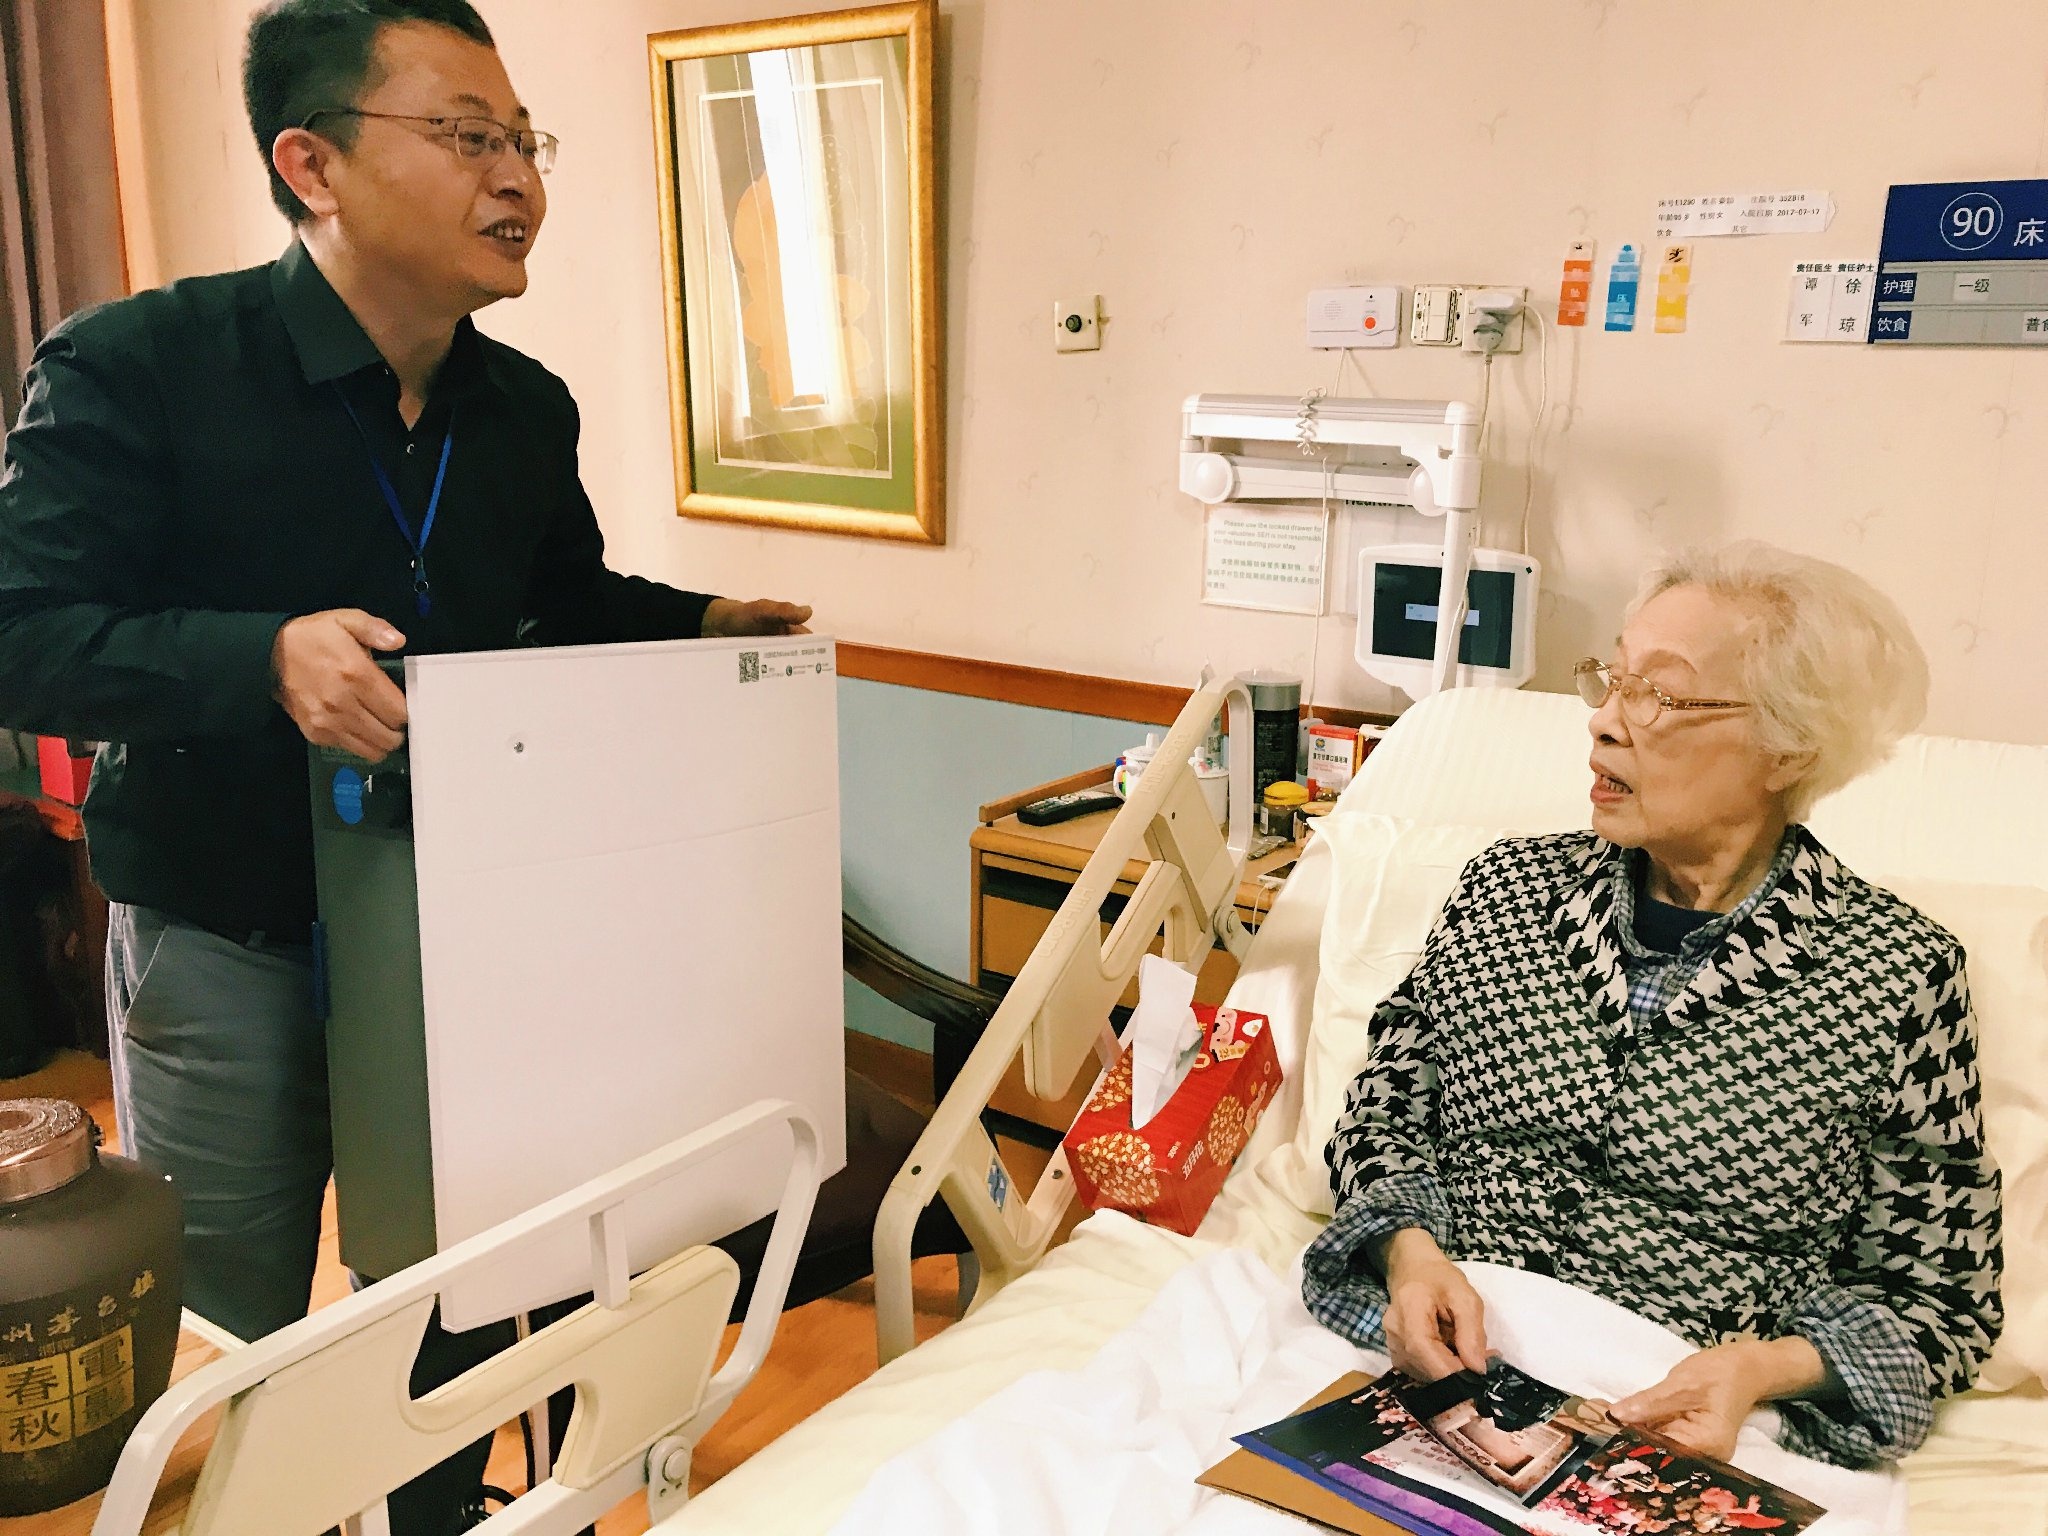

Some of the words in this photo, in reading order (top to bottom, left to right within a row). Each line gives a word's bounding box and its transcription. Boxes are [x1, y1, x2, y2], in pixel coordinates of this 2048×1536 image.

[1777, 208, 1820, 217] 2017-07-17
[1953, 206, 1995, 237] 90
[2014, 218, 2046, 246] 床
[1796, 263, 1832, 273] 责任医生
[1838, 263, 1875, 273] 责任护士
[1883, 279, 1914, 295] 护理
[1959, 278, 1990, 293] 一级
[1877, 316, 1908, 332] 饮食
[1224, 519, 1244, 528] Please
[1291, 523, 1313, 532] drawer
